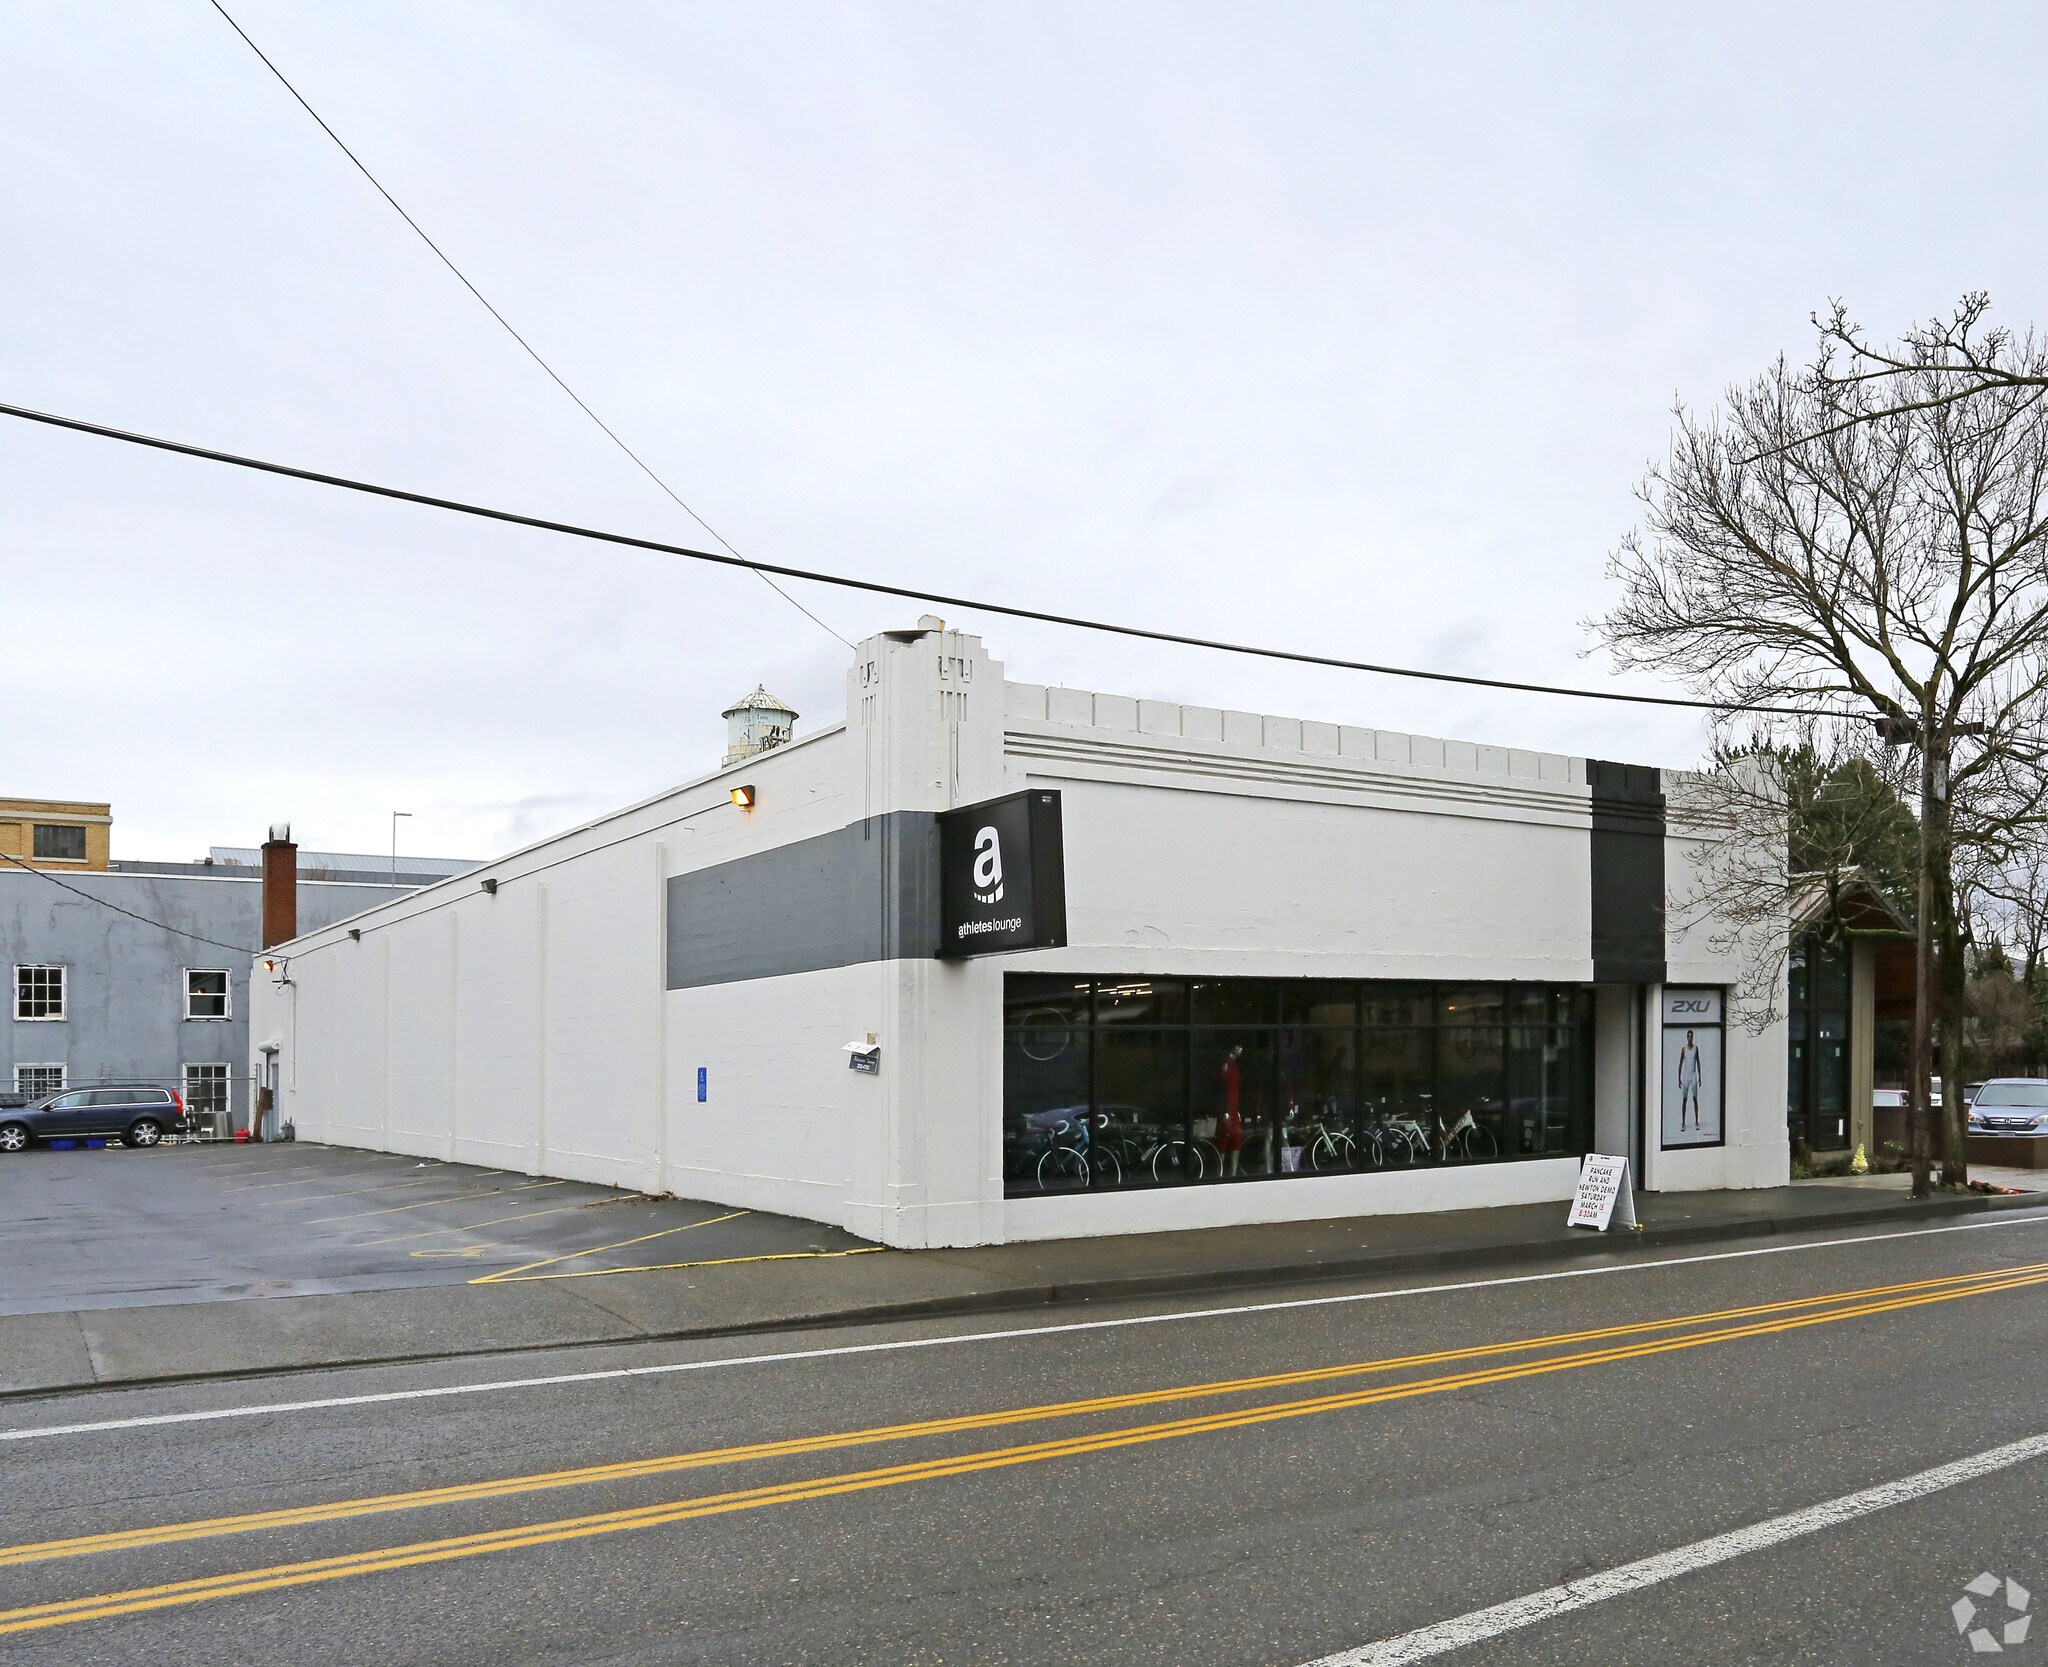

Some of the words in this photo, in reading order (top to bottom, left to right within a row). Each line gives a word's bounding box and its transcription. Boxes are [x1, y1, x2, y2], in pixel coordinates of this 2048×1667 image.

[1671, 1000, 1711, 1013] 2XU
[1590, 1167, 1613, 1175] PANCAKE
[1579, 1184, 1599, 1192] NEWTON
[1600, 1186, 1615, 1194] DEMO
[1581, 1192, 1607, 1201] SATURDAY
[1581, 1201, 1598, 1209] MARCH
